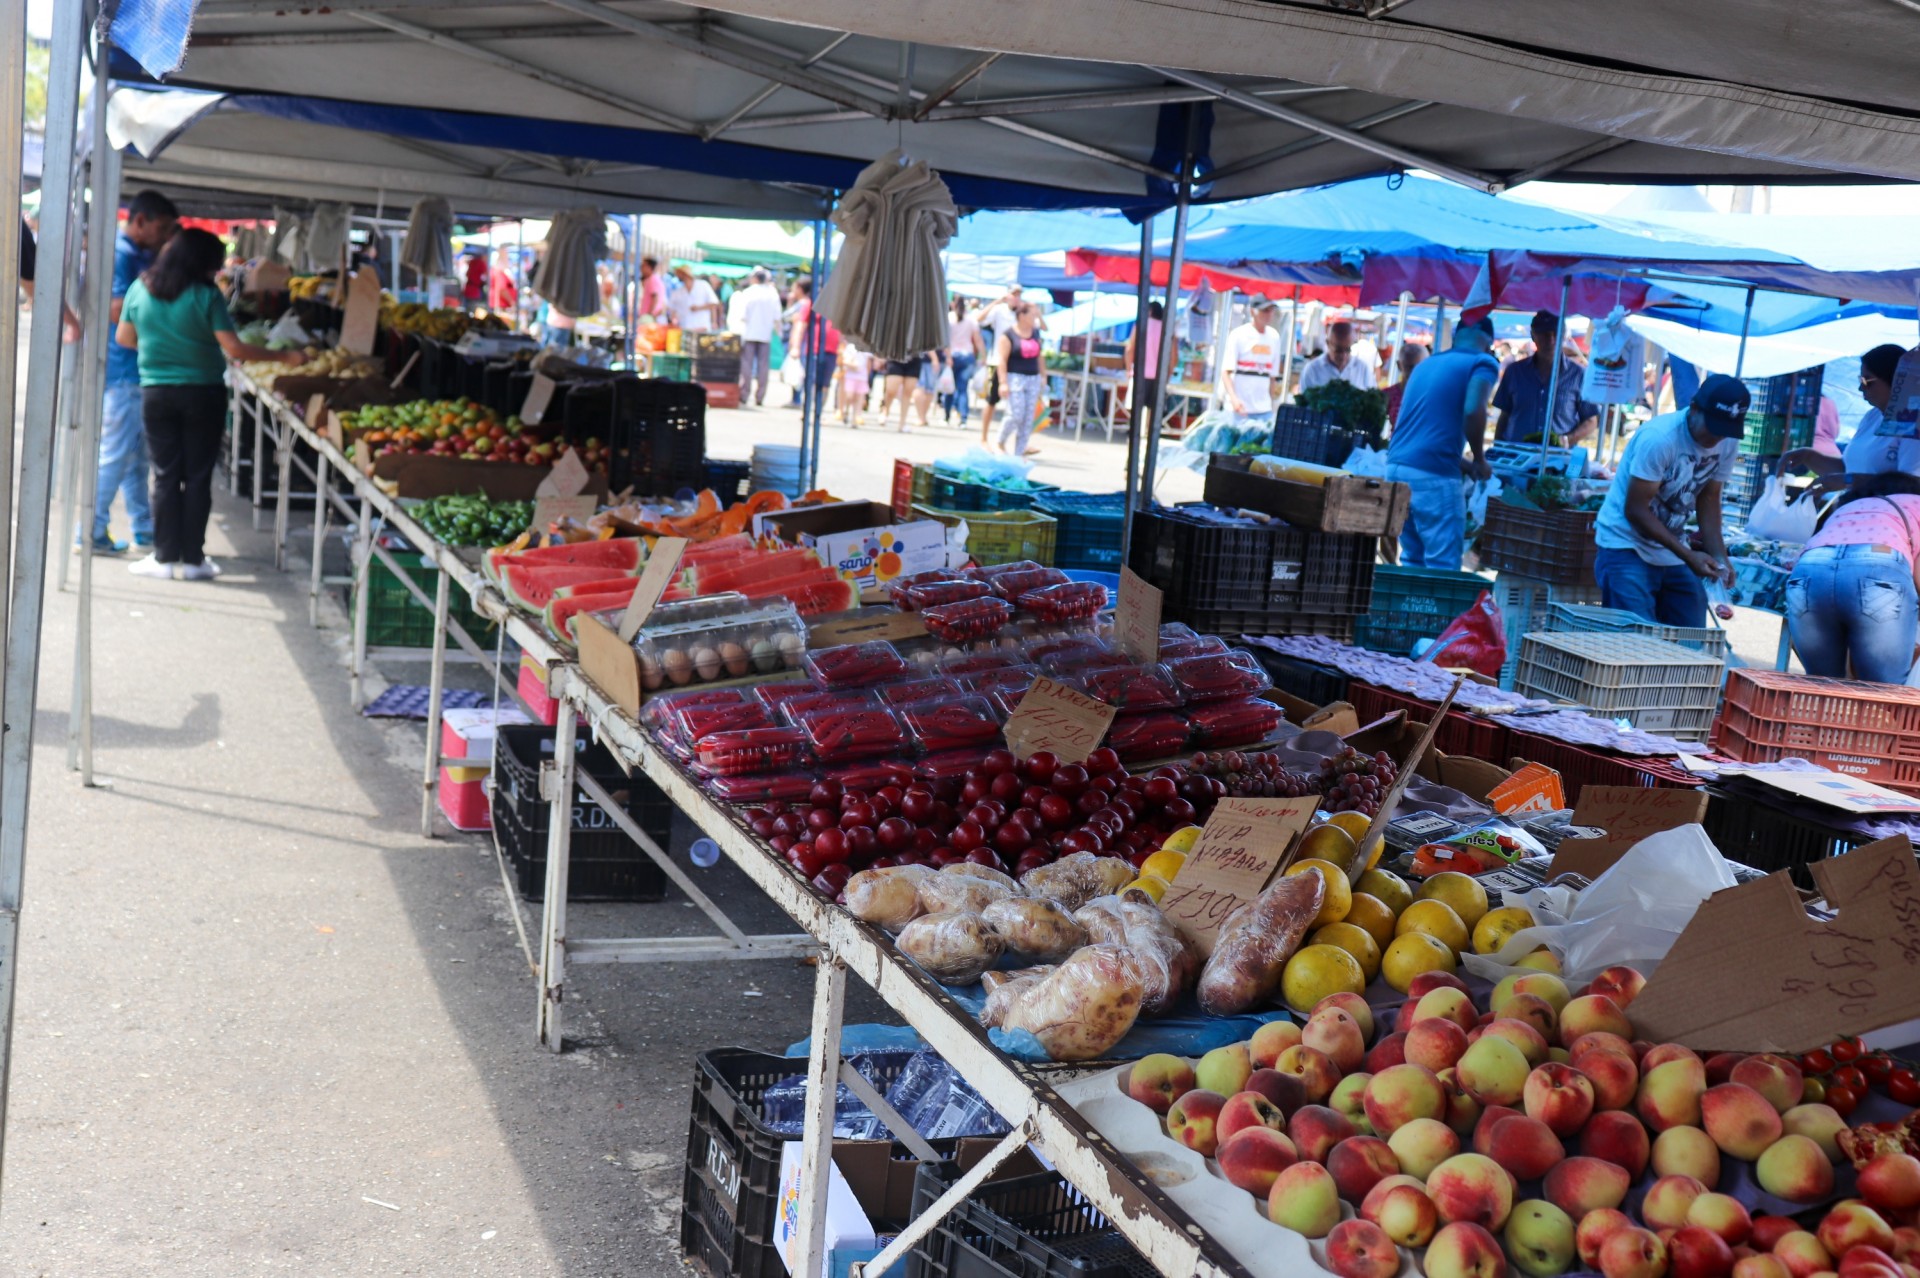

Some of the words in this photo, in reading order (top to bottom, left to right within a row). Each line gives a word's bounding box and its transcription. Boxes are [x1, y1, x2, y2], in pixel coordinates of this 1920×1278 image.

[839, 557, 872, 570] sano
[1405, 595, 1436, 606] FRUTAS
[1401, 602, 1438, 613] OLIVEIRA
[1828, 753, 1881, 766] HORTIFRUTI
[1837, 764, 1868, 775] COSTA
[1465, 834, 1496, 848] caju
